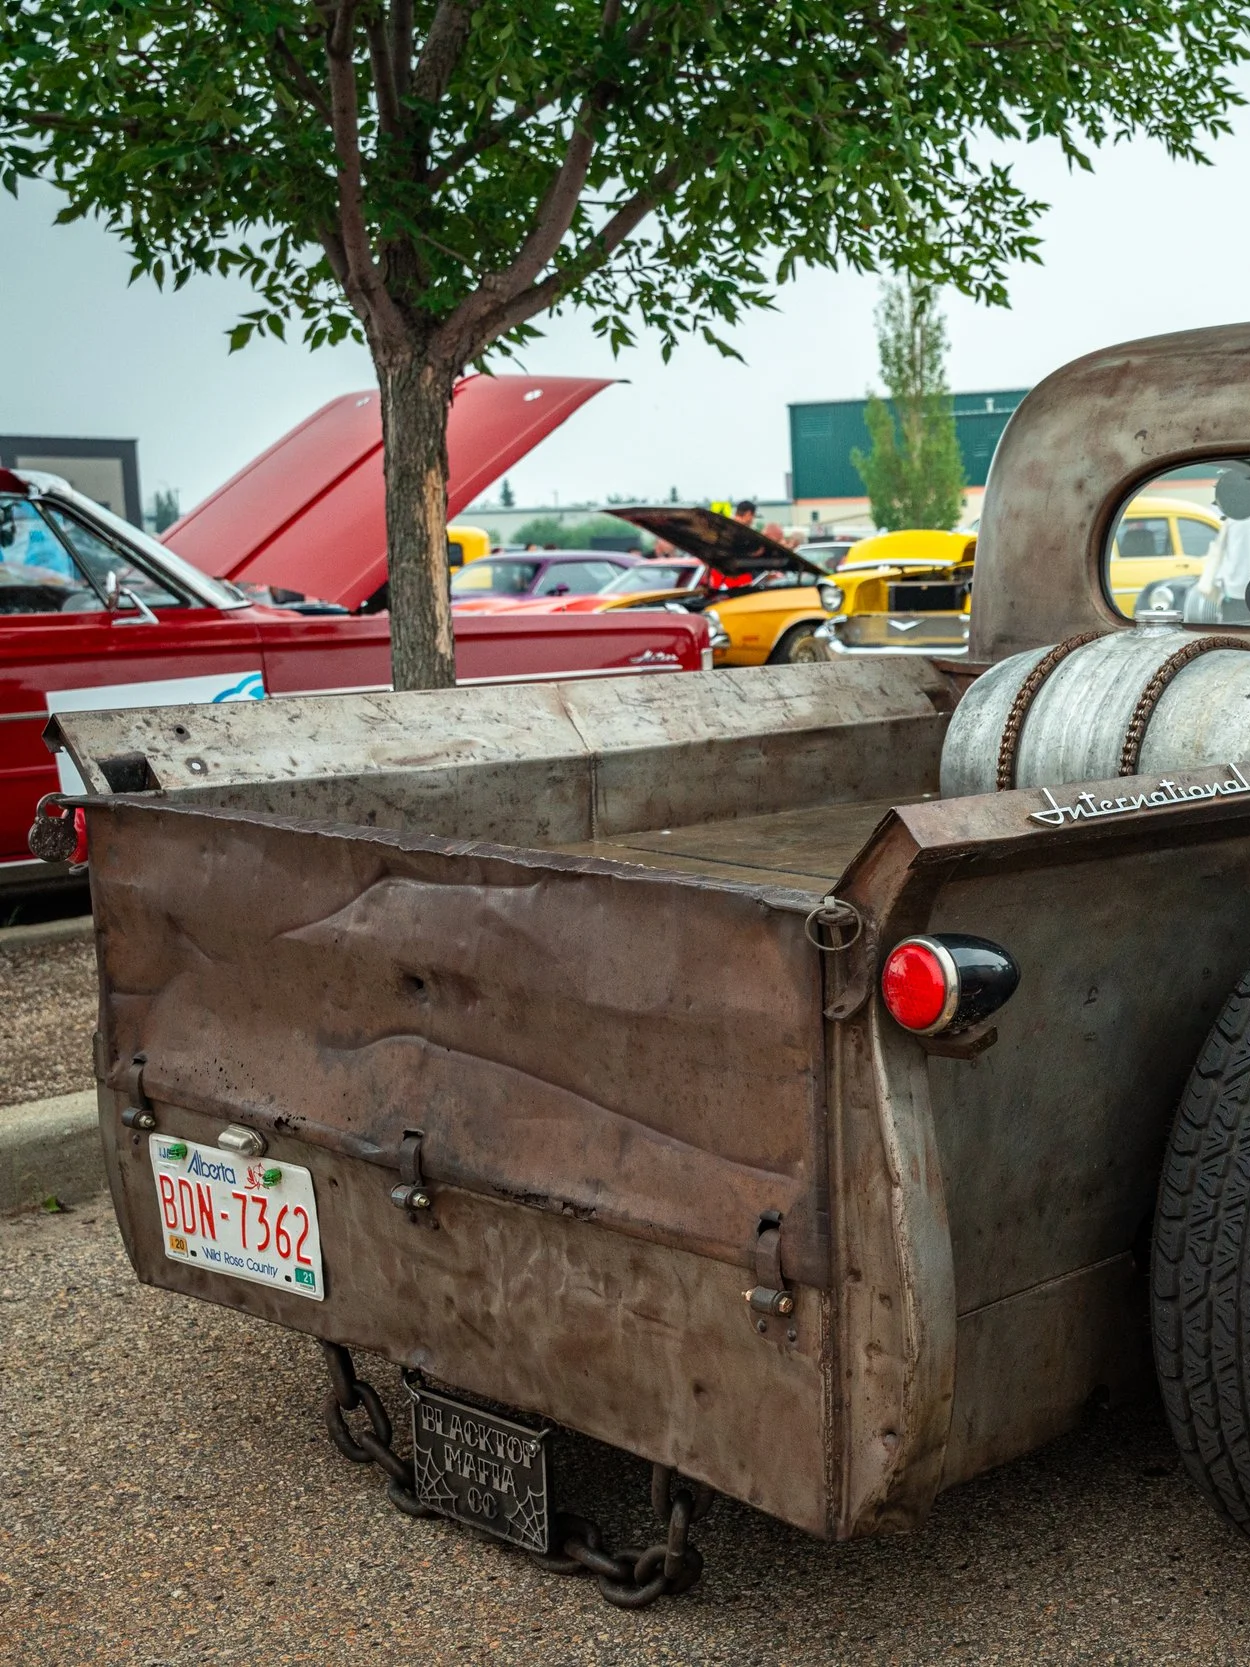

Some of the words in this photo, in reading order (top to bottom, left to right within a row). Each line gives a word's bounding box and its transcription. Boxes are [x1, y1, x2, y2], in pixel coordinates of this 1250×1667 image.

[187, 1150, 236, 1185] Alberta
[158, 1173, 312, 1266] BDN-7362
[175, 1237, 185, 1250] 20
[202, 1246, 222, 1262] Wild
[224, 1251, 245, 1268] Rose
[246, 1258, 279, 1278] Country
[303, 1271, 313, 1284] 21
[421, 1403, 537, 1469] BLACKTOP
[444, 1443, 517, 1498] MAFIA
